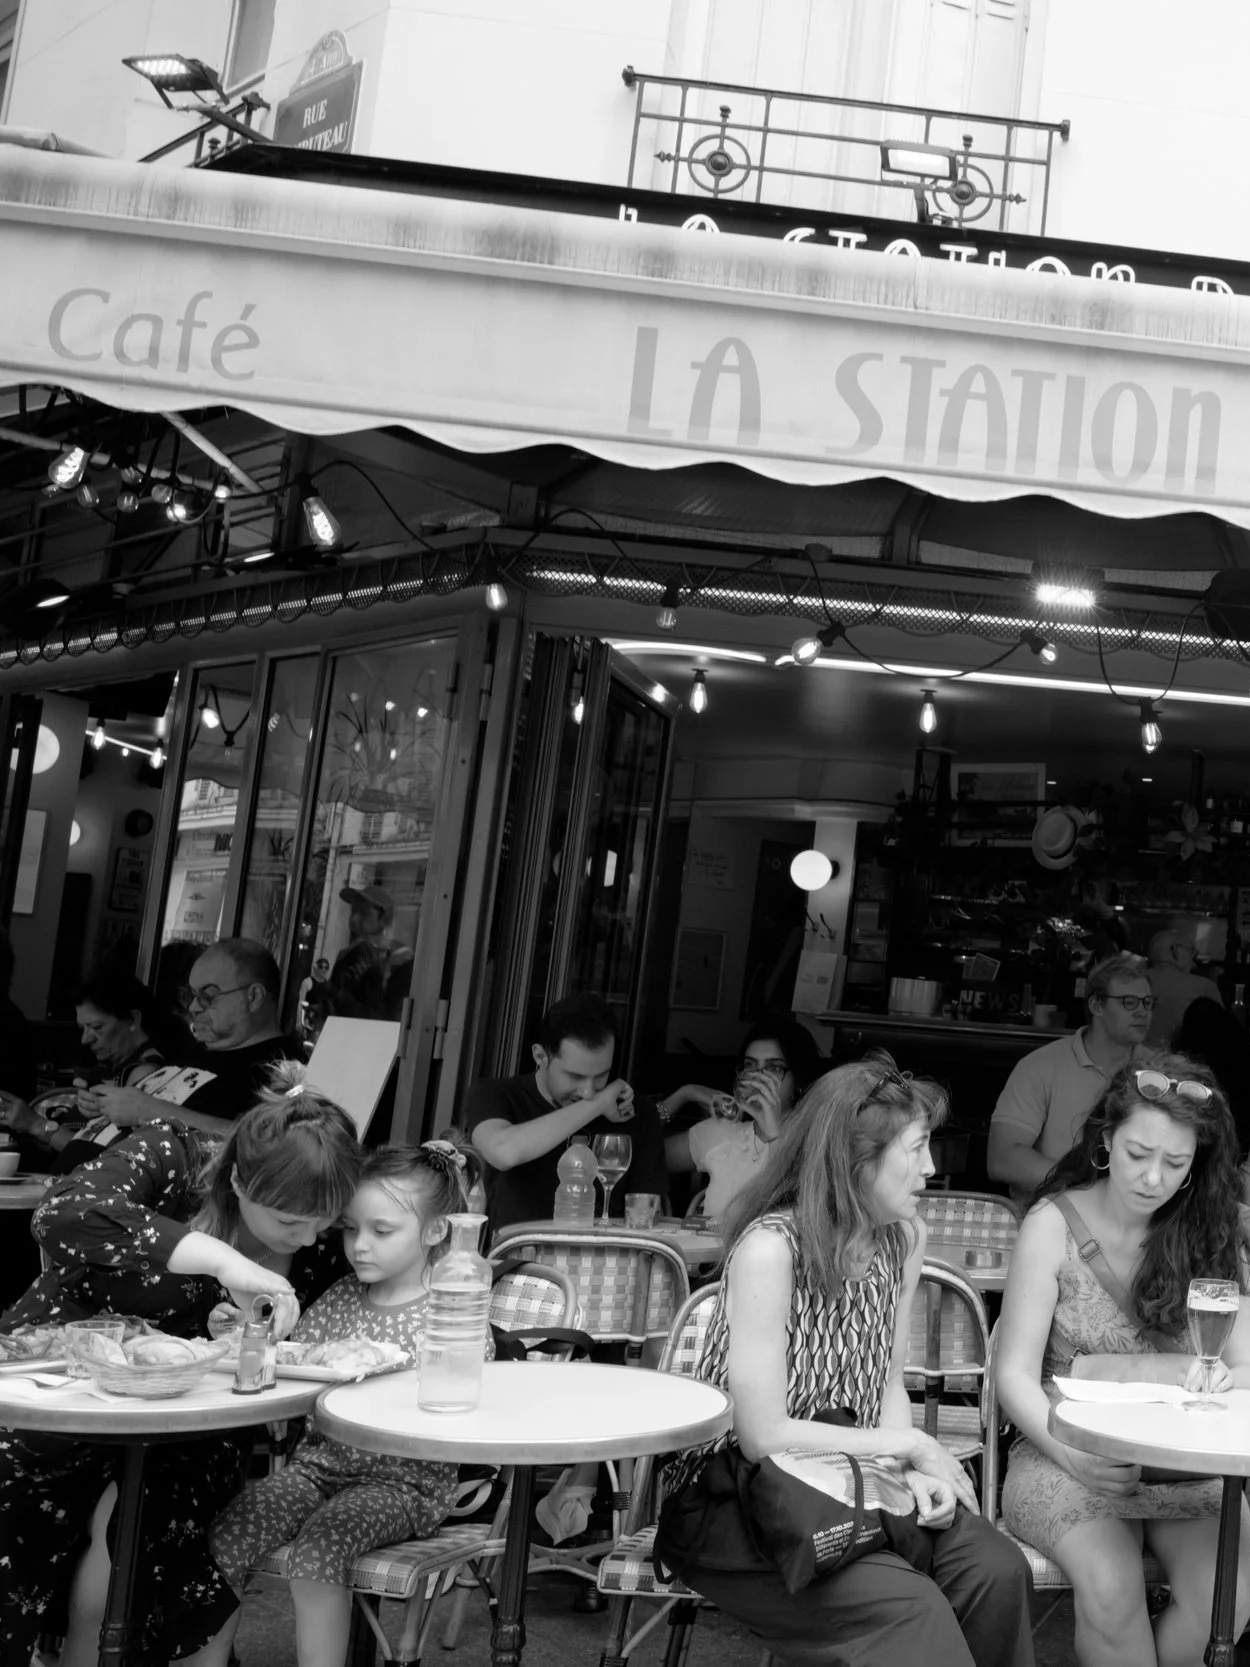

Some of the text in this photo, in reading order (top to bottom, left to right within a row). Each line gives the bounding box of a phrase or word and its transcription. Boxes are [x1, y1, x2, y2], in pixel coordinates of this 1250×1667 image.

[303, 99, 327, 128] RUE
[295, 121, 348, 151] BUTEAU
[48, 288, 259, 380] Café
[626, 327, 762, 446] LA
[960, 989, 1020, 1012] NEWS
[814, 1534, 834, 1546] Festival
